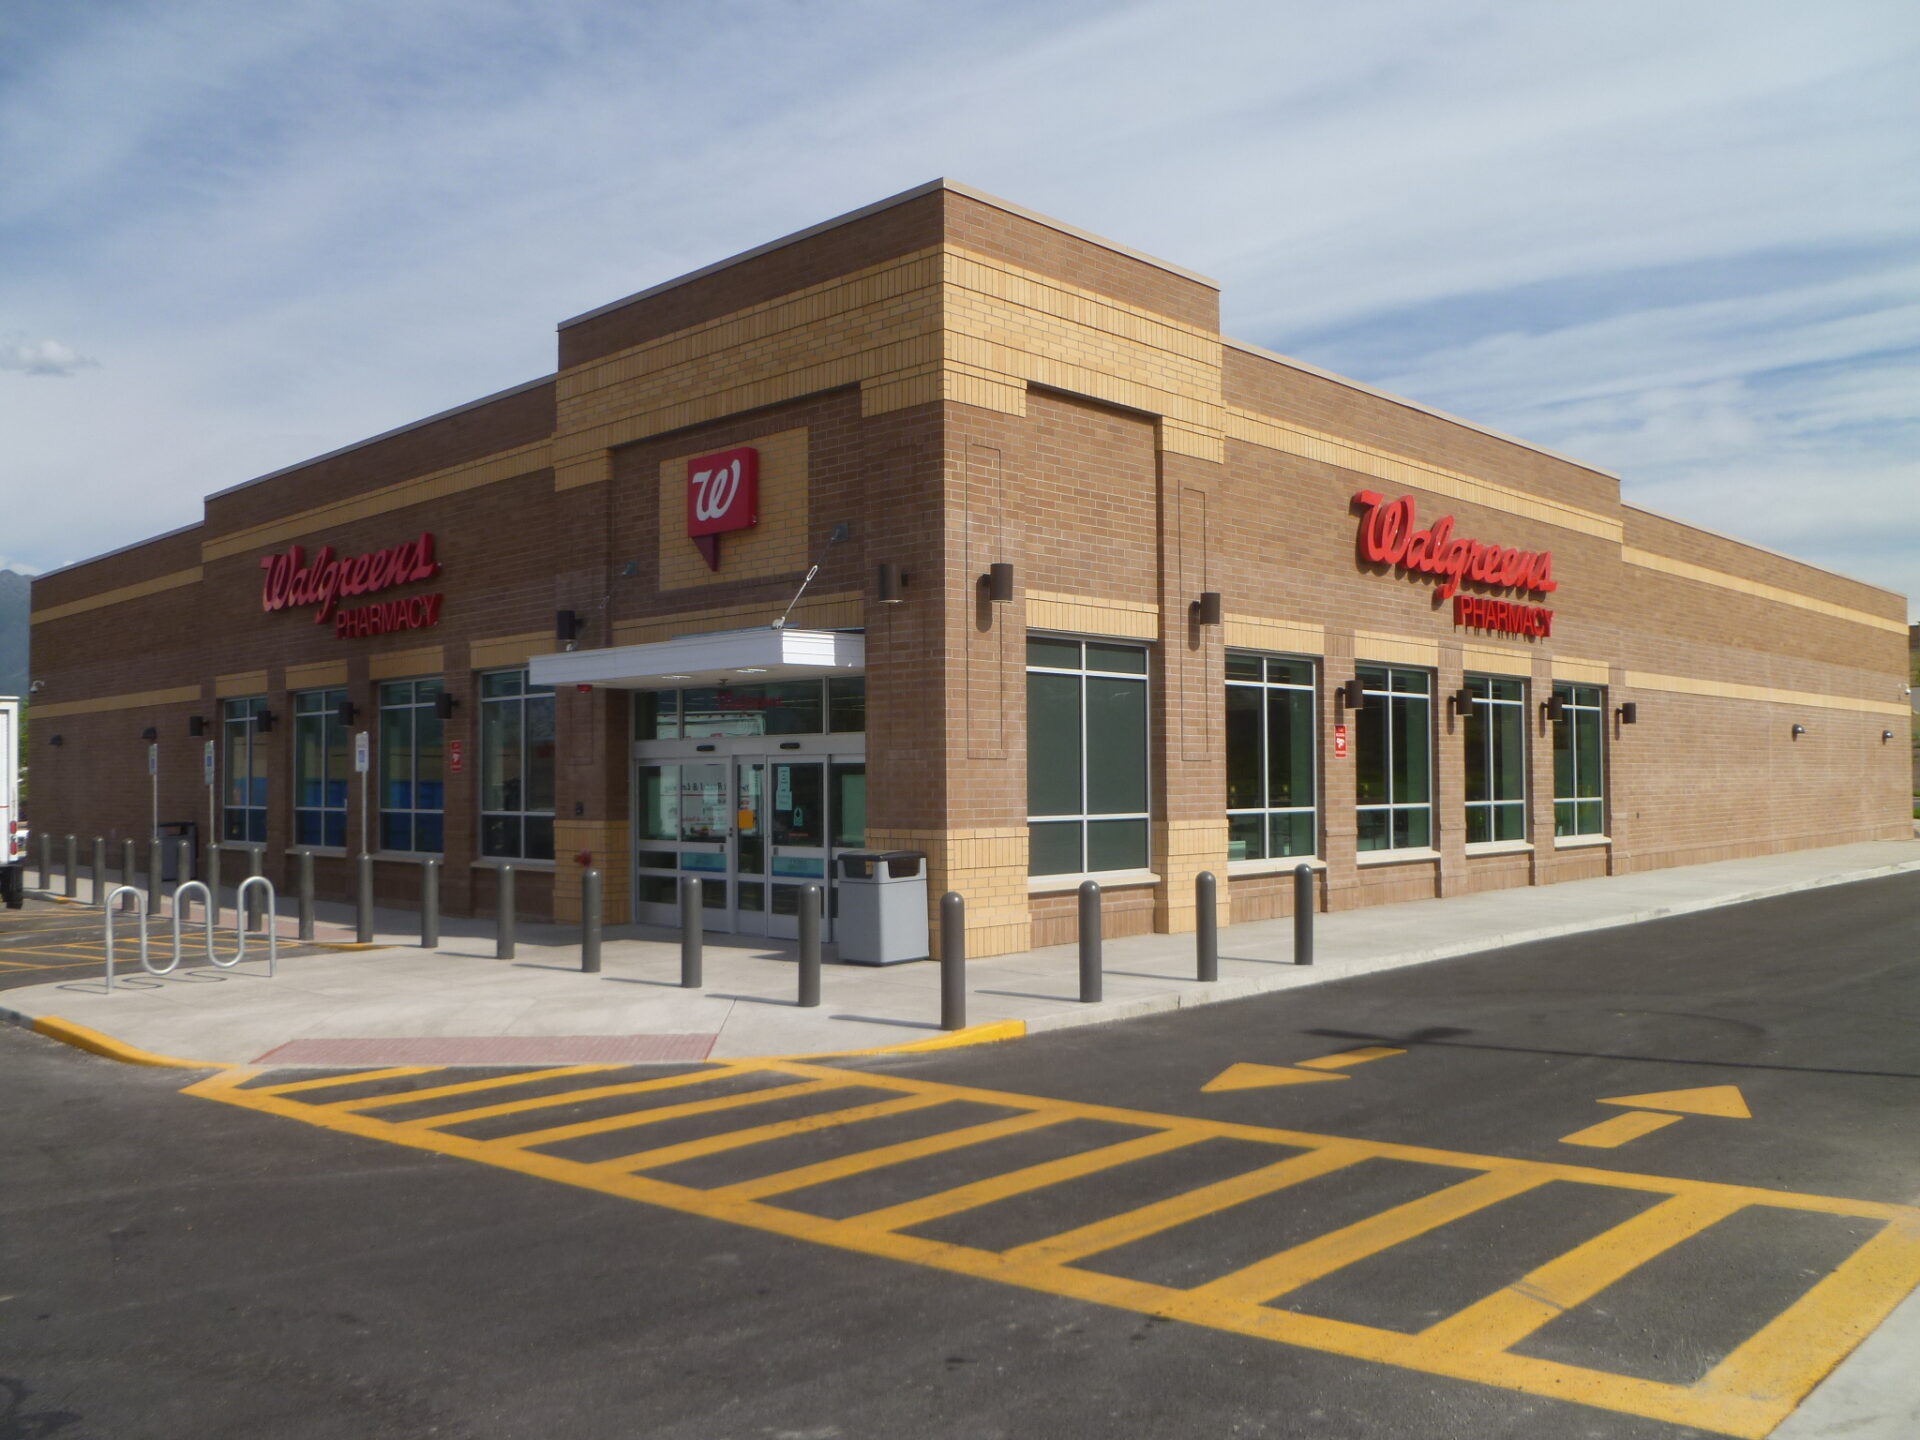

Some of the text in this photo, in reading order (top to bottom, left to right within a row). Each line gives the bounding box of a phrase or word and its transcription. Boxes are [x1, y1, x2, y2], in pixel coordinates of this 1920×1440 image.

[692, 458, 741, 522] W
[1352, 489, 1557, 599] Walgreens
[260, 531, 435, 624] Walgreens
[336, 593, 443, 639] PHARMACY
[1455, 595, 1554, 637] PHARMACY
